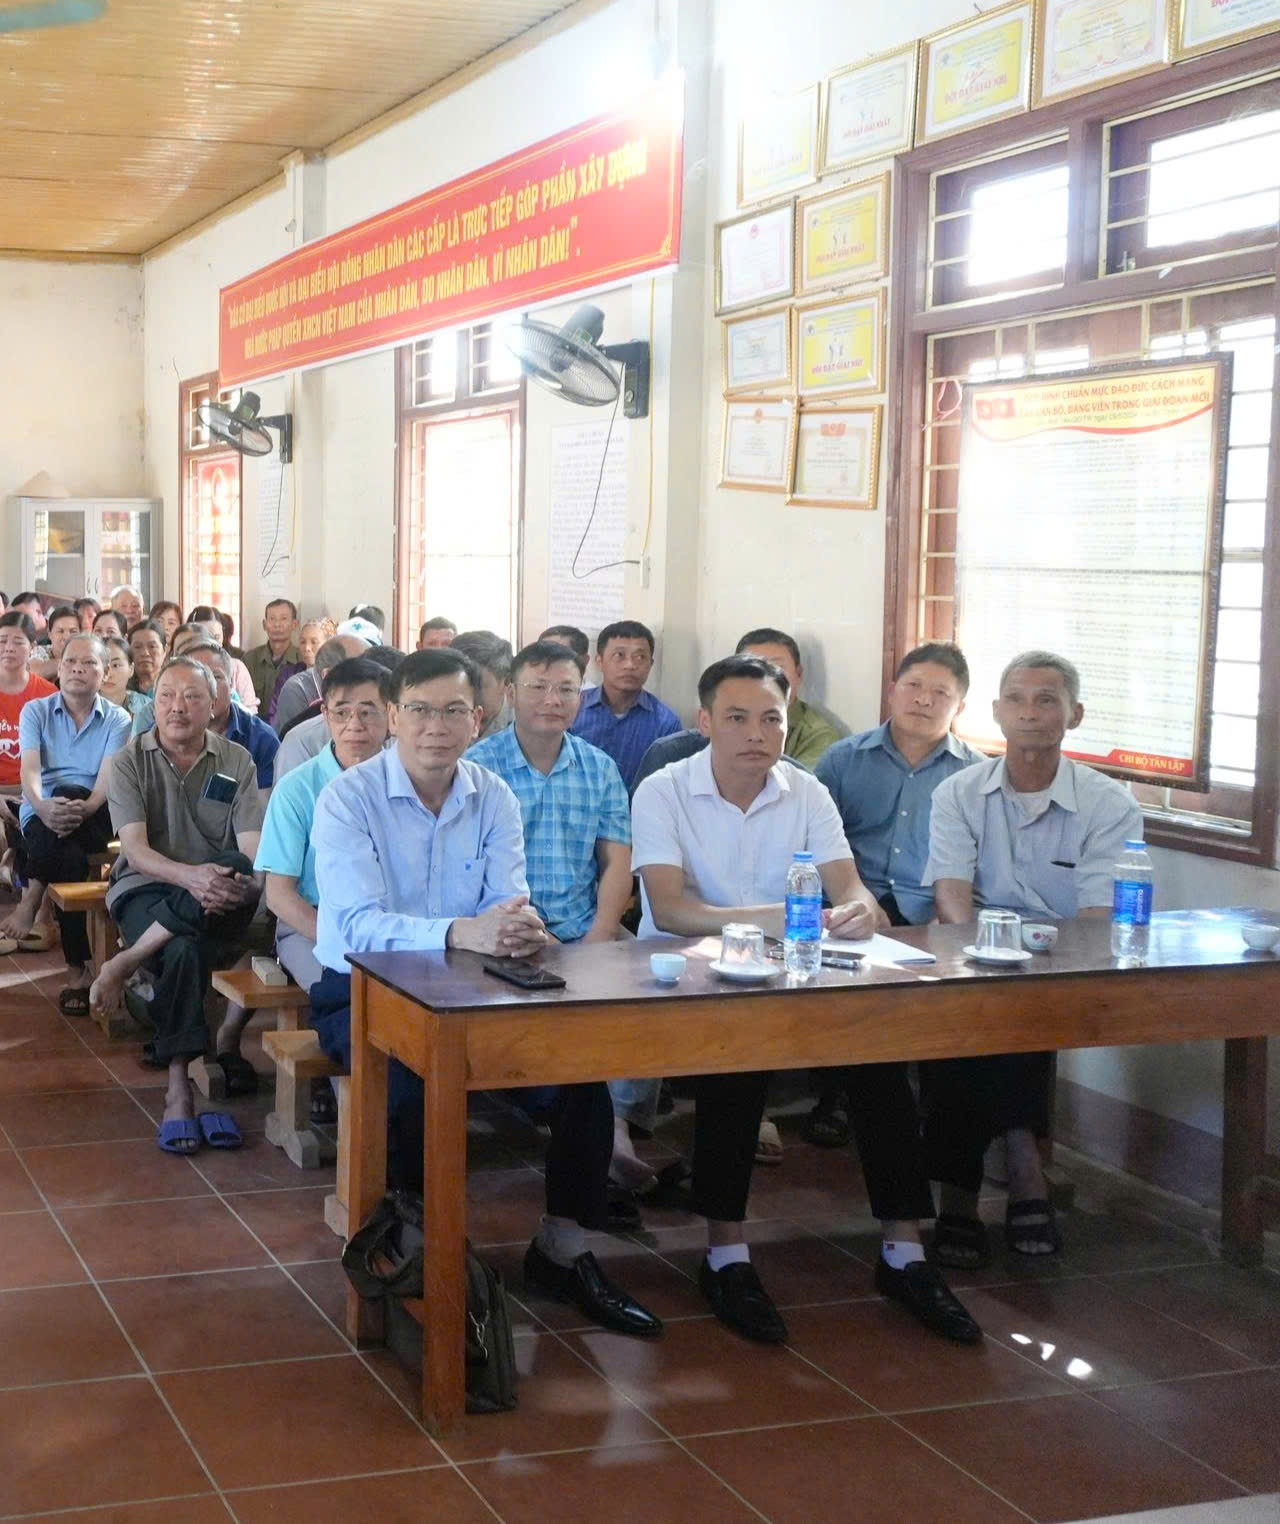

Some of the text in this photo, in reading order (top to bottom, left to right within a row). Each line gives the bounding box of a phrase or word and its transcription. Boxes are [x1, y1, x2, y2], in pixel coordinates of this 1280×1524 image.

[341, 250, 362, 286] ĐỒNG
[362, 242, 386, 278] NHÂN
[387, 234, 405, 270] DÂN
[406, 227, 425, 263] CÁC
[426, 213, 446, 256] CẤP
[447, 210, 460, 248] LÀ
[462, 204, 488, 245] TRỰC
[490, 186, 514, 232] TIẾP
[516, 179, 539, 223] GÓP
[541, 160, 577, 212] PHẦN
[578, 153, 605, 199] XÂY
[303, 311, 321, 342] XHCN
[322, 305, 337, 339] VIỆT
[338, 301, 356, 331] NAM
[357, 288, 373, 324] CỦA
[374, 283, 398, 321] NHÂN
[422, 274, 436, 305] DO
[437, 261, 464, 301] NHÂN
[492, 244, 504, 283] VÌ
[505, 235, 538, 279] NHÂN
[1111, 397, 1141, 411] TRONG
[1119, 754, 1135, 765] CHI
[1149, 756, 1169, 769] TÂN
